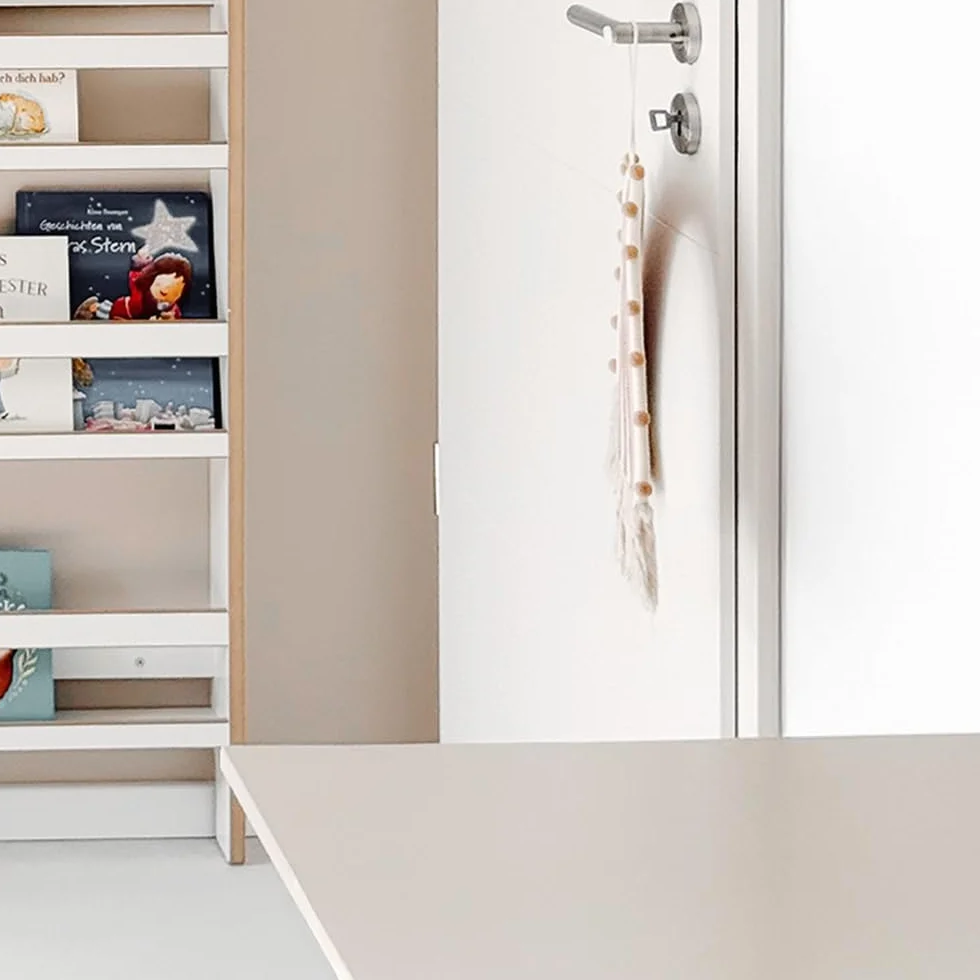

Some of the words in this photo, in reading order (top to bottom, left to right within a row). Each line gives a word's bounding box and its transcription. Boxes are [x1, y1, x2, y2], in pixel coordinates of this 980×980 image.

[15, 73, 37, 83] dich
[39, 72, 66, 84] hab?
[40, 219, 103, 232] Geschichten
[91, 236, 136, 254] Stern
